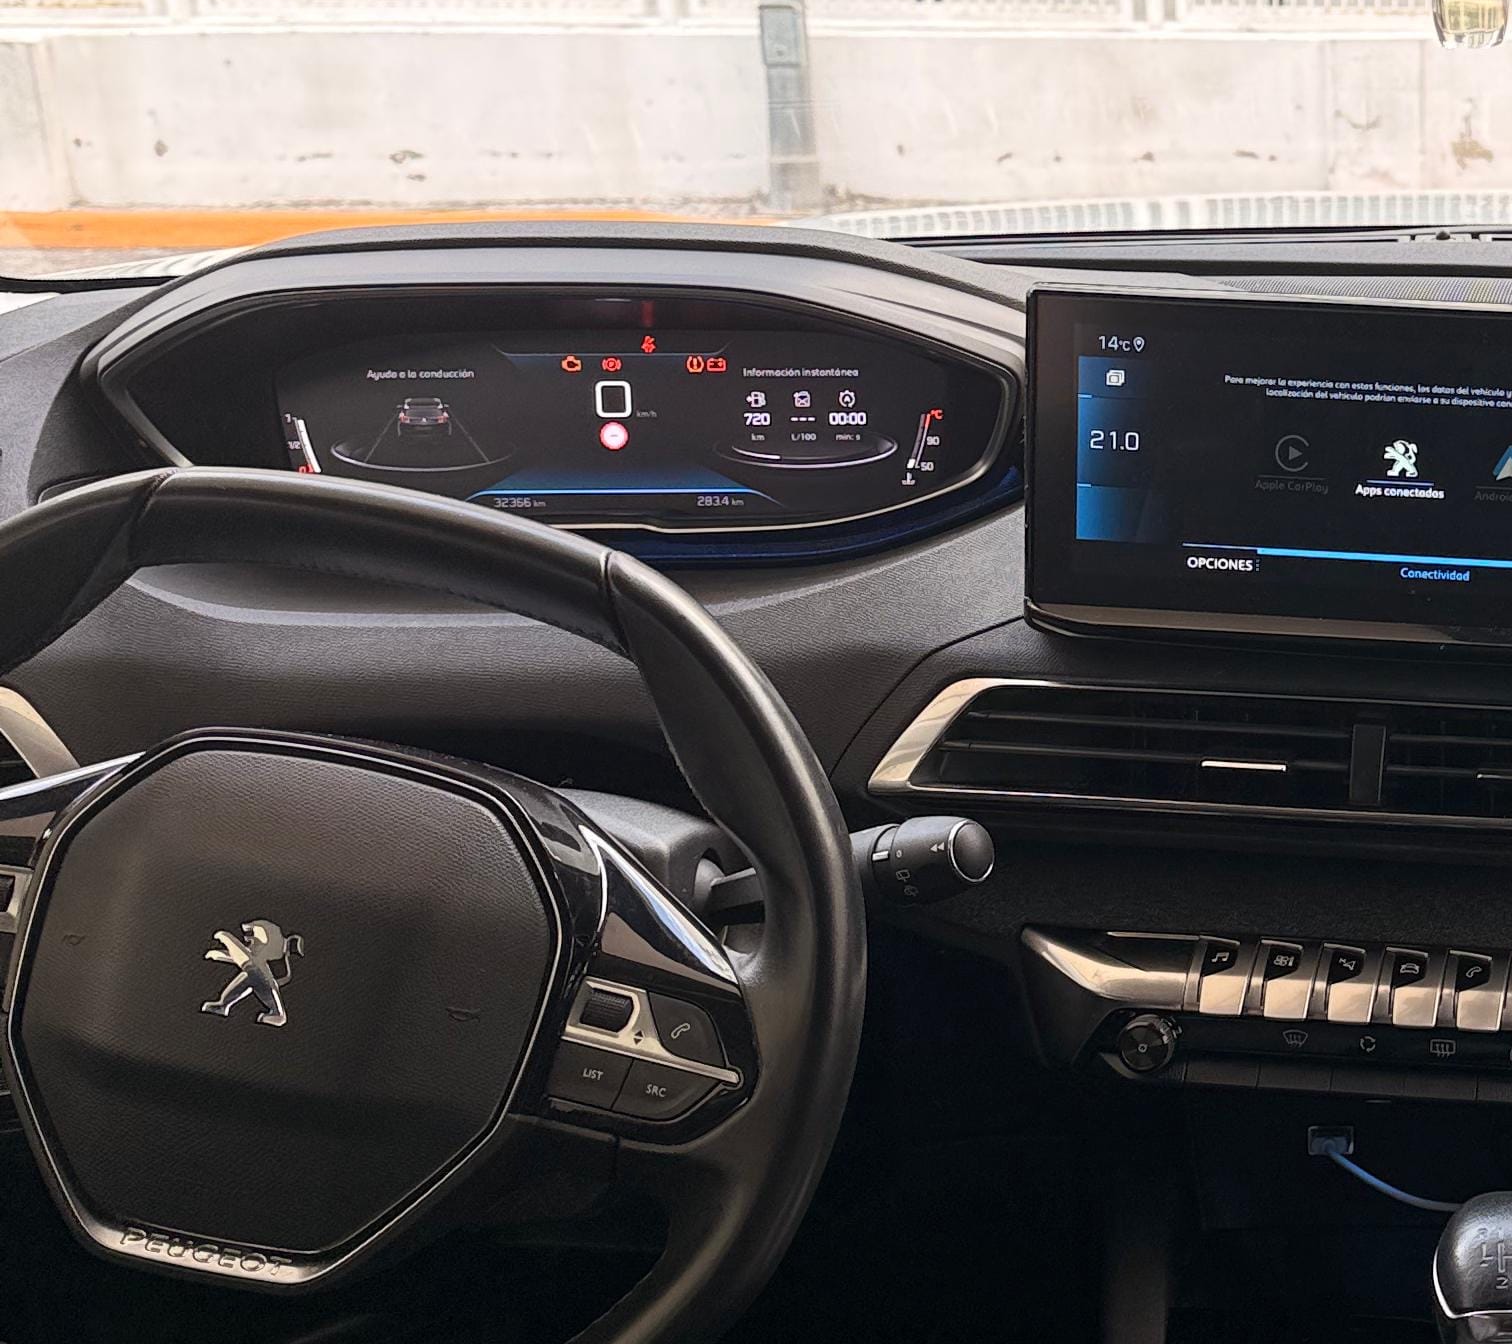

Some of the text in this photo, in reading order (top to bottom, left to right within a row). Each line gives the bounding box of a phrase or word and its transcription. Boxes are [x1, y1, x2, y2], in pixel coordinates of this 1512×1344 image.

[367, 369, 398, 381] Ayuda
[407, 369, 417, 379] la
[419, 369, 475, 379] conducción
[743, 367, 859, 378] Información instantánea
[1224, 375, 1244, 384] Para
[1245, 377, 1276, 387] mejorar
[1277, 378, 1286, 386] la
[1287, 379, 1334, 390] experiencia
[1374, 382, 1416, 393] funciones,
[1417, 384, 1430, 394] los
[1432, 385, 1455, 394] datos
[1456, 386, 1469, 395] del
[1506, 390, 1512, 399] y
[594, 380, 633, 418] 0
[1266, 388, 1314, 398] localización
[1315, 389, 1328, 399] del
[1397, 396, 1431, 405] enviarse
[1451, 397, 1495, 407] dispositivo
[636, 410, 657, 418] km/h
[744, 412, 771, 426] 720
[829, 412, 867, 426] 00:00
[751, 433, 765, 441] km
[791, 433, 817, 441] L/100
[927, 436, 940, 446] 90
[1090, 430, 1140, 452] 21.0
[920, 461, 934, 472] 50
[1255, 480, 1329, 495] Apple CarPlay
[1355, 484, 1445, 499] Apps conectadas
[494, 497, 546, 508] 32366 km
[731, 498, 744, 507] km
[1187, 557, 1253, 572] OPCIONES
[1400, 567, 1470, 582] Conectividad
[583, 1068, 604, 1080] LIST
[645, 1084, 667, 1097] SRC
[120, 1227, 292, 1275] PEUGEOT
